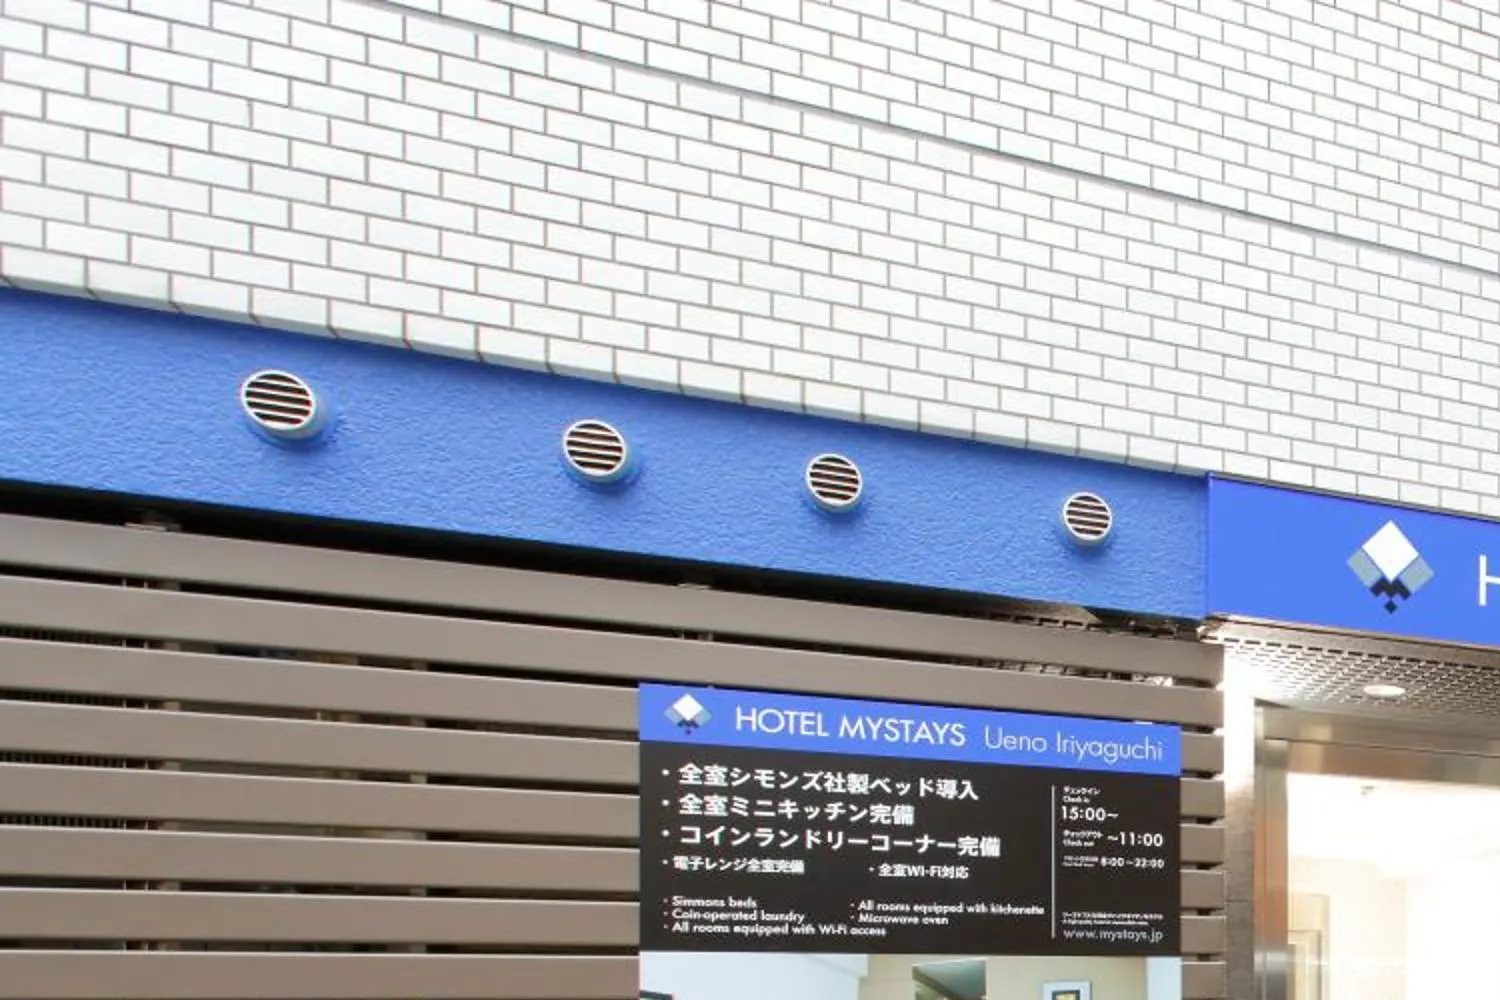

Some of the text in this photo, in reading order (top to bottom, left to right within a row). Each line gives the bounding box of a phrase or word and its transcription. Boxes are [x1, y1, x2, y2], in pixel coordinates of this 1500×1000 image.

[736, 707, 1161, 762] HOTEL MYSTAYS Ueno Iriyaguchi
[677, 763, 980, 801] 全室シモンズ社製ベッド導入
[677, 794, 915, 825] 全室ミニキッチン完備
[679, 825, 1001, 858] コインランドリーコーナー完備
[672, 896, 757, 908] Simmons beds
[858, 900, 874, 910] All
[877, 904, 910, 912] rooms
[913, 902, 964, 914] equipped
[966, 903, 988, 913] with
[761, 910, 805, 924] laundry
[858, 913, 919, 924] Microwave
[672, 922, 689, 932] All
[693, 925, 730, 933] rooms
[733, 924, 787, 936] equipped
[792, 924, 815, 934] with
[850, 928, 886, 936] access
[1064, 930, 1162, 942] www.mystays.jp
